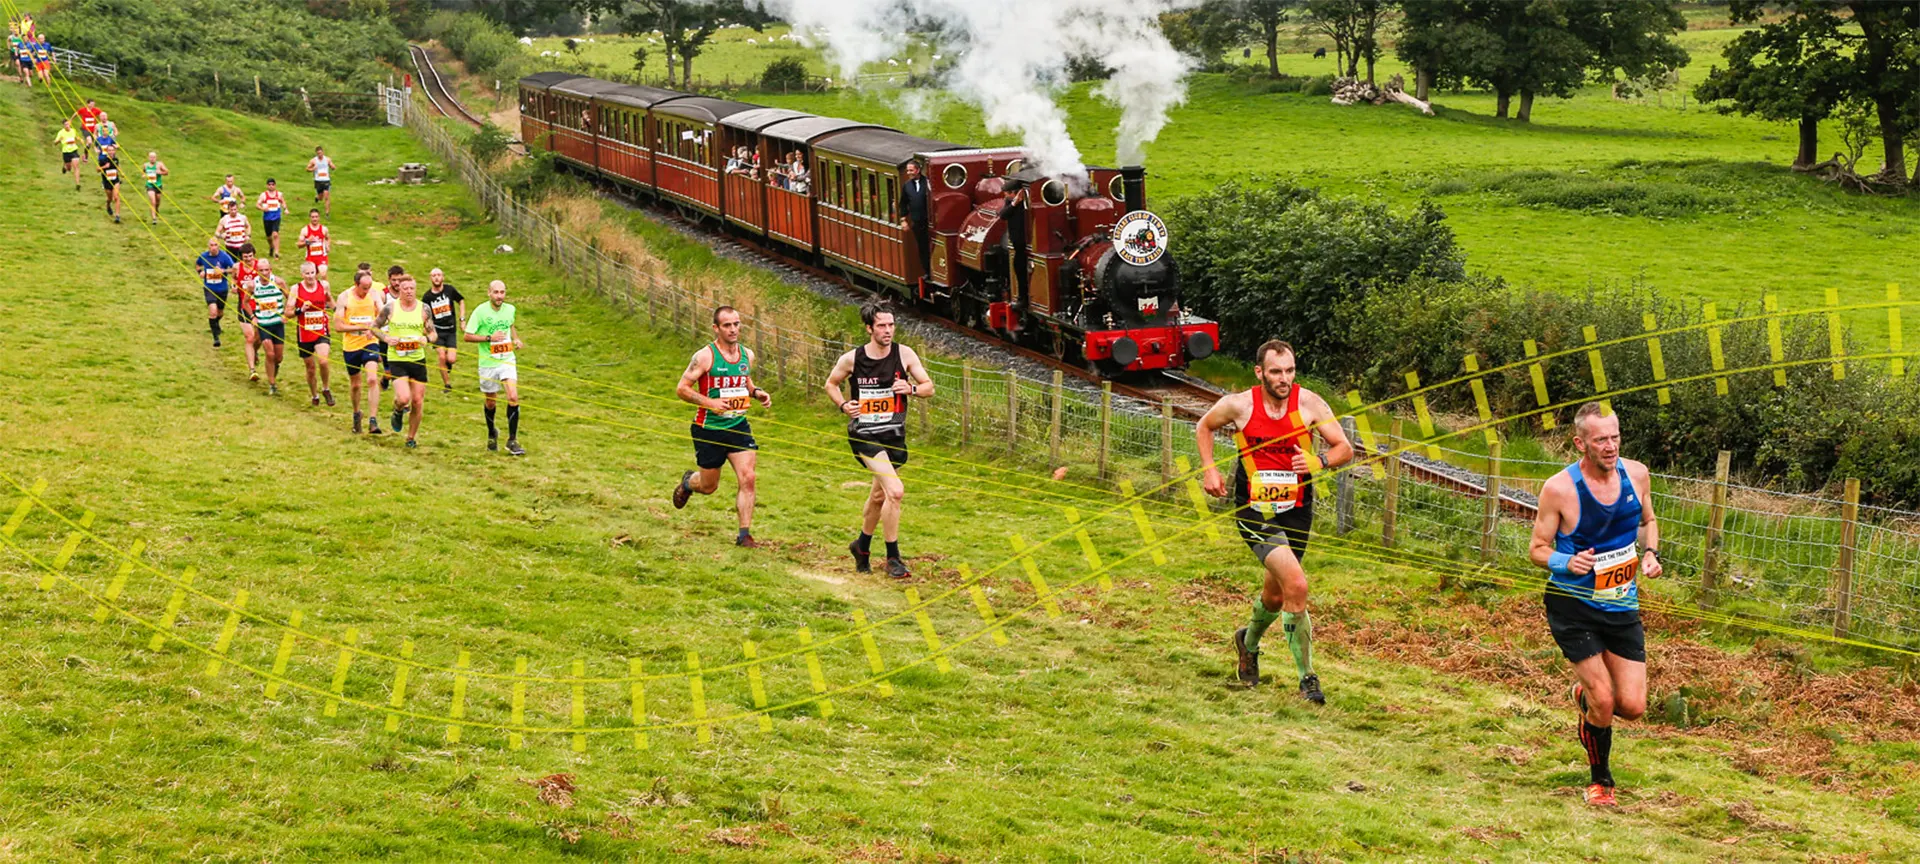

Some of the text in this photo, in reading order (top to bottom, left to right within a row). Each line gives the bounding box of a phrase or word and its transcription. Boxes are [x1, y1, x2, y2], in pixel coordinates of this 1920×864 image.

[1120, 249, 1134, 262] RACE
[494, 345, 509, 354] 831
[857, 377, 879, 385] BRAT
[865, 400, 889, 412] 150
[1258, 487, 1289, 501] 804
[1604, 564, 1632, 587] 760
